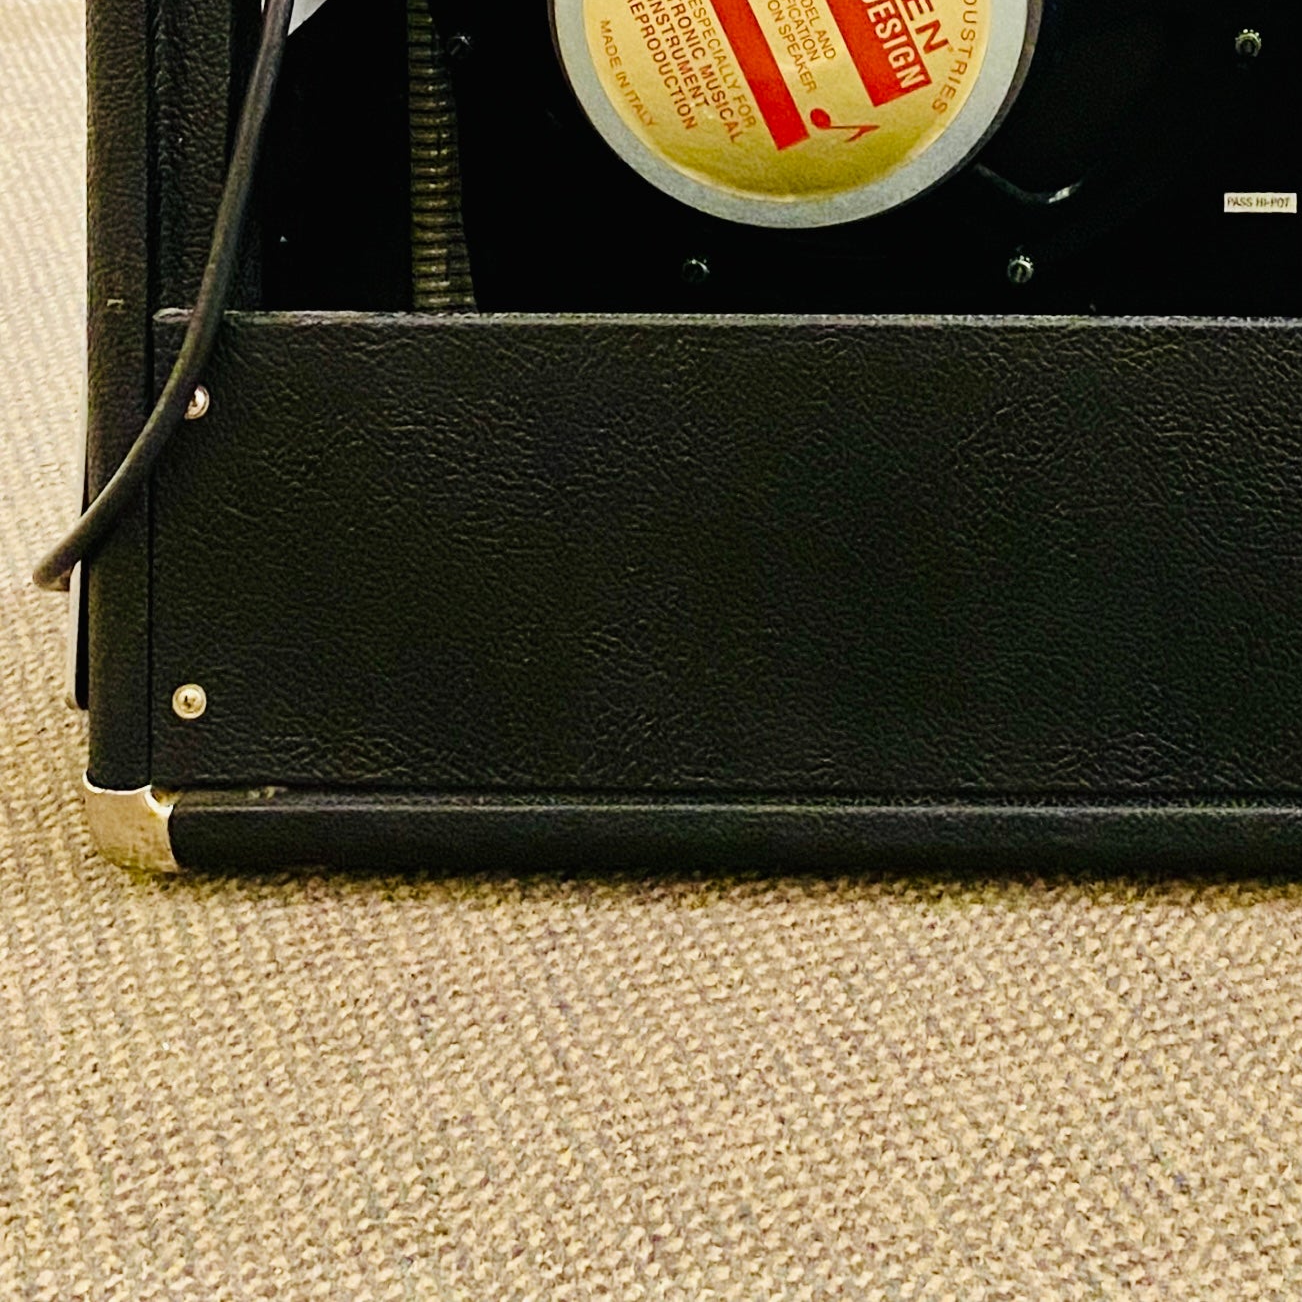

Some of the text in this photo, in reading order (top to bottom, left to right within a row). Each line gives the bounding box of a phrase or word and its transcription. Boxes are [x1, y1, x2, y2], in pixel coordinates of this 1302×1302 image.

[600, 18, 658, 127] MADE IN ITALY
[768, 0, 785, 22] ON
[778, 24, 817, 93] SPEAKER
[814, 28, 836, 60] AND
[699, 64, 743, 143] MUSICAL
[732, 94, 757, 129] FOR
[1227, 197, 1290, 208] PASS HI-POT
